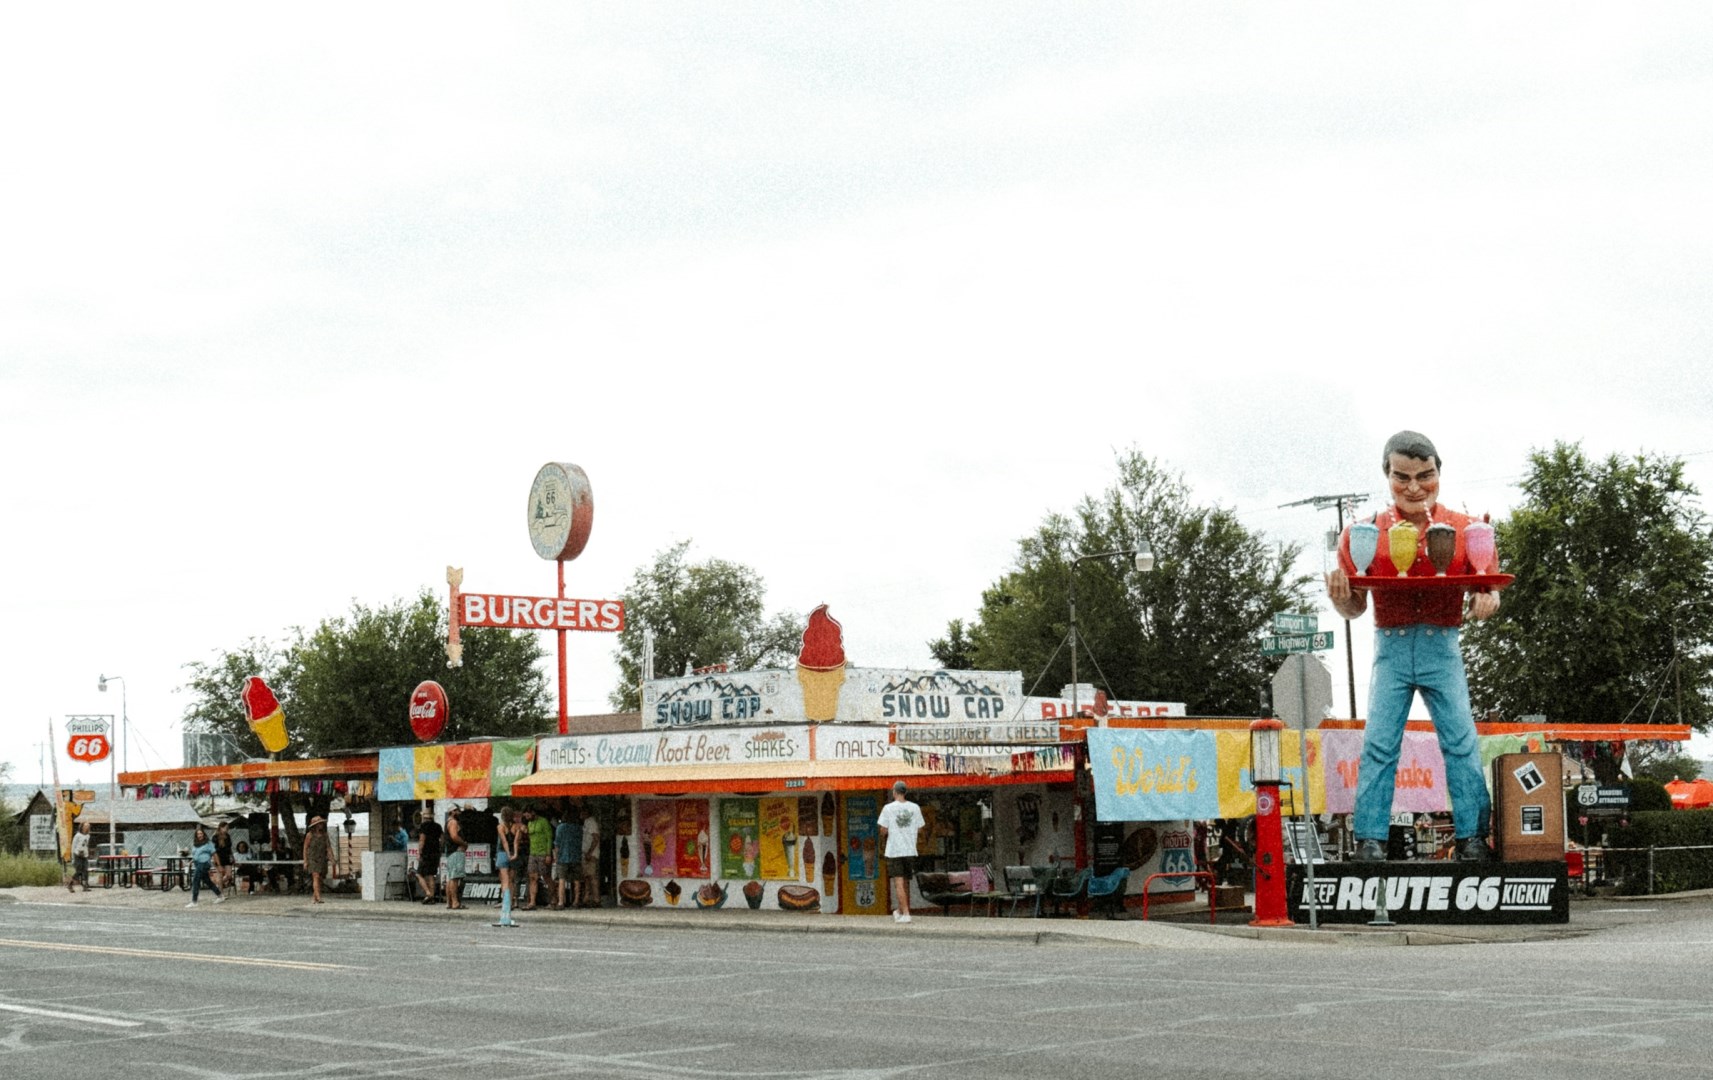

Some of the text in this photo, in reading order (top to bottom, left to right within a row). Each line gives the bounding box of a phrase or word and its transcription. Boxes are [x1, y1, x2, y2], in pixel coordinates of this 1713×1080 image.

[545, 491, 556, 505] 66
[464, 595, 620, 629] BURGERS
[1262, 634, 1325, 654] Old Highway 66
[656, 696, 761, 725] SNOW CAP
[882, 694, 1004, 719] SNOW CAP
[72, 724, 104, 733] PHILLIPS
[897, 725, 1058, 743] CHEESEBURGER CHEESE
[73, 738, 102, 757] 66
[550, 734, 795, 767] MALTS Creamy Root Beer SHAKES
[835, 739, 886, 759] MALTS
[1111, 745, 1199, 797] World's
[1580, 791, 1596, 804] 66
[1164, 835, 1188, 848] ROUTE
[1165, 852, 1189, 873] 66
[860, 895, 872, 906] 66
[1336, 876, 1453, 911] ROUTE
[1455, 876, 1502, 911] 66
[1501, 882, 1555, 905] KICKIN'
